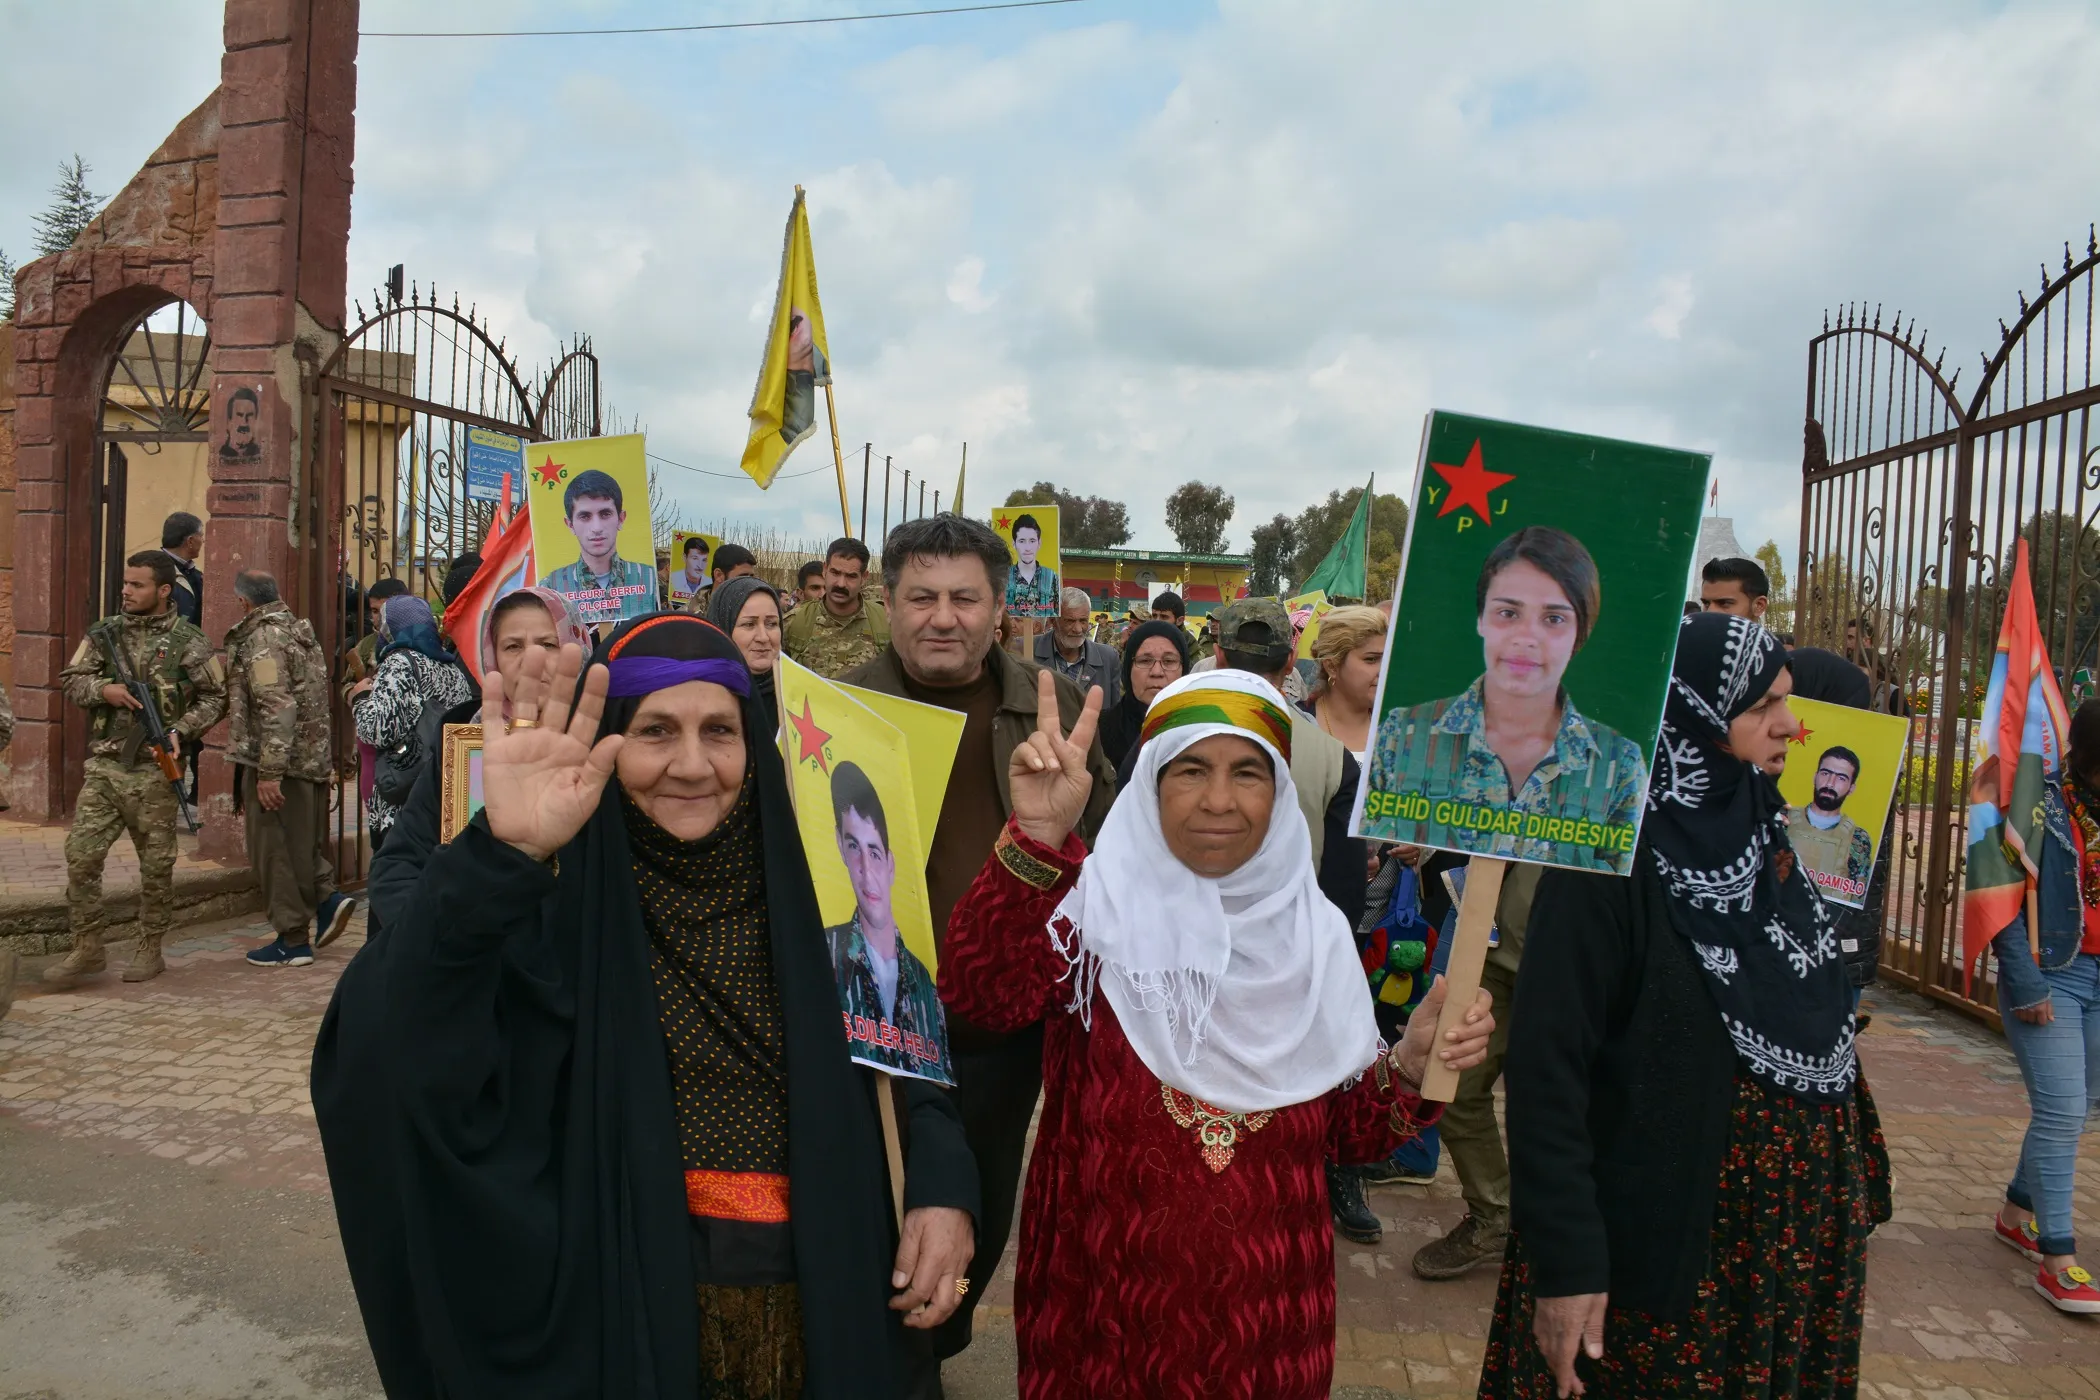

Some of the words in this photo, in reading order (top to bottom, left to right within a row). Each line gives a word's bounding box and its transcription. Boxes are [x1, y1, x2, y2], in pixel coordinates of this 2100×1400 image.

[531, 472, 540, 482] Y
[548, 481, 556, 490] P
[559, 469, 568, 479] G
[1427, 485, 1441, 505] Y
[1457, 516, 1473, 533] P
[1494, 498, 1508, 515] J
[565, 588, 606, 601] ELGURT
[609, 585, 646, 597] BERFIN
[791, 729, 798, 744] Y
[811, 759, 818, 772] P
[824, 746, 833, 761] G
[1367, 790, 1430, 820] ŞEHÎD
[1434, 801, 1521, 834] GULDAR
[1525, 815, 1636, 852] DIRBÊSIYÊ
[1817, 871, 1866, 896] QAMIŞLO
[903, 1029, 939, 1064] HELO
